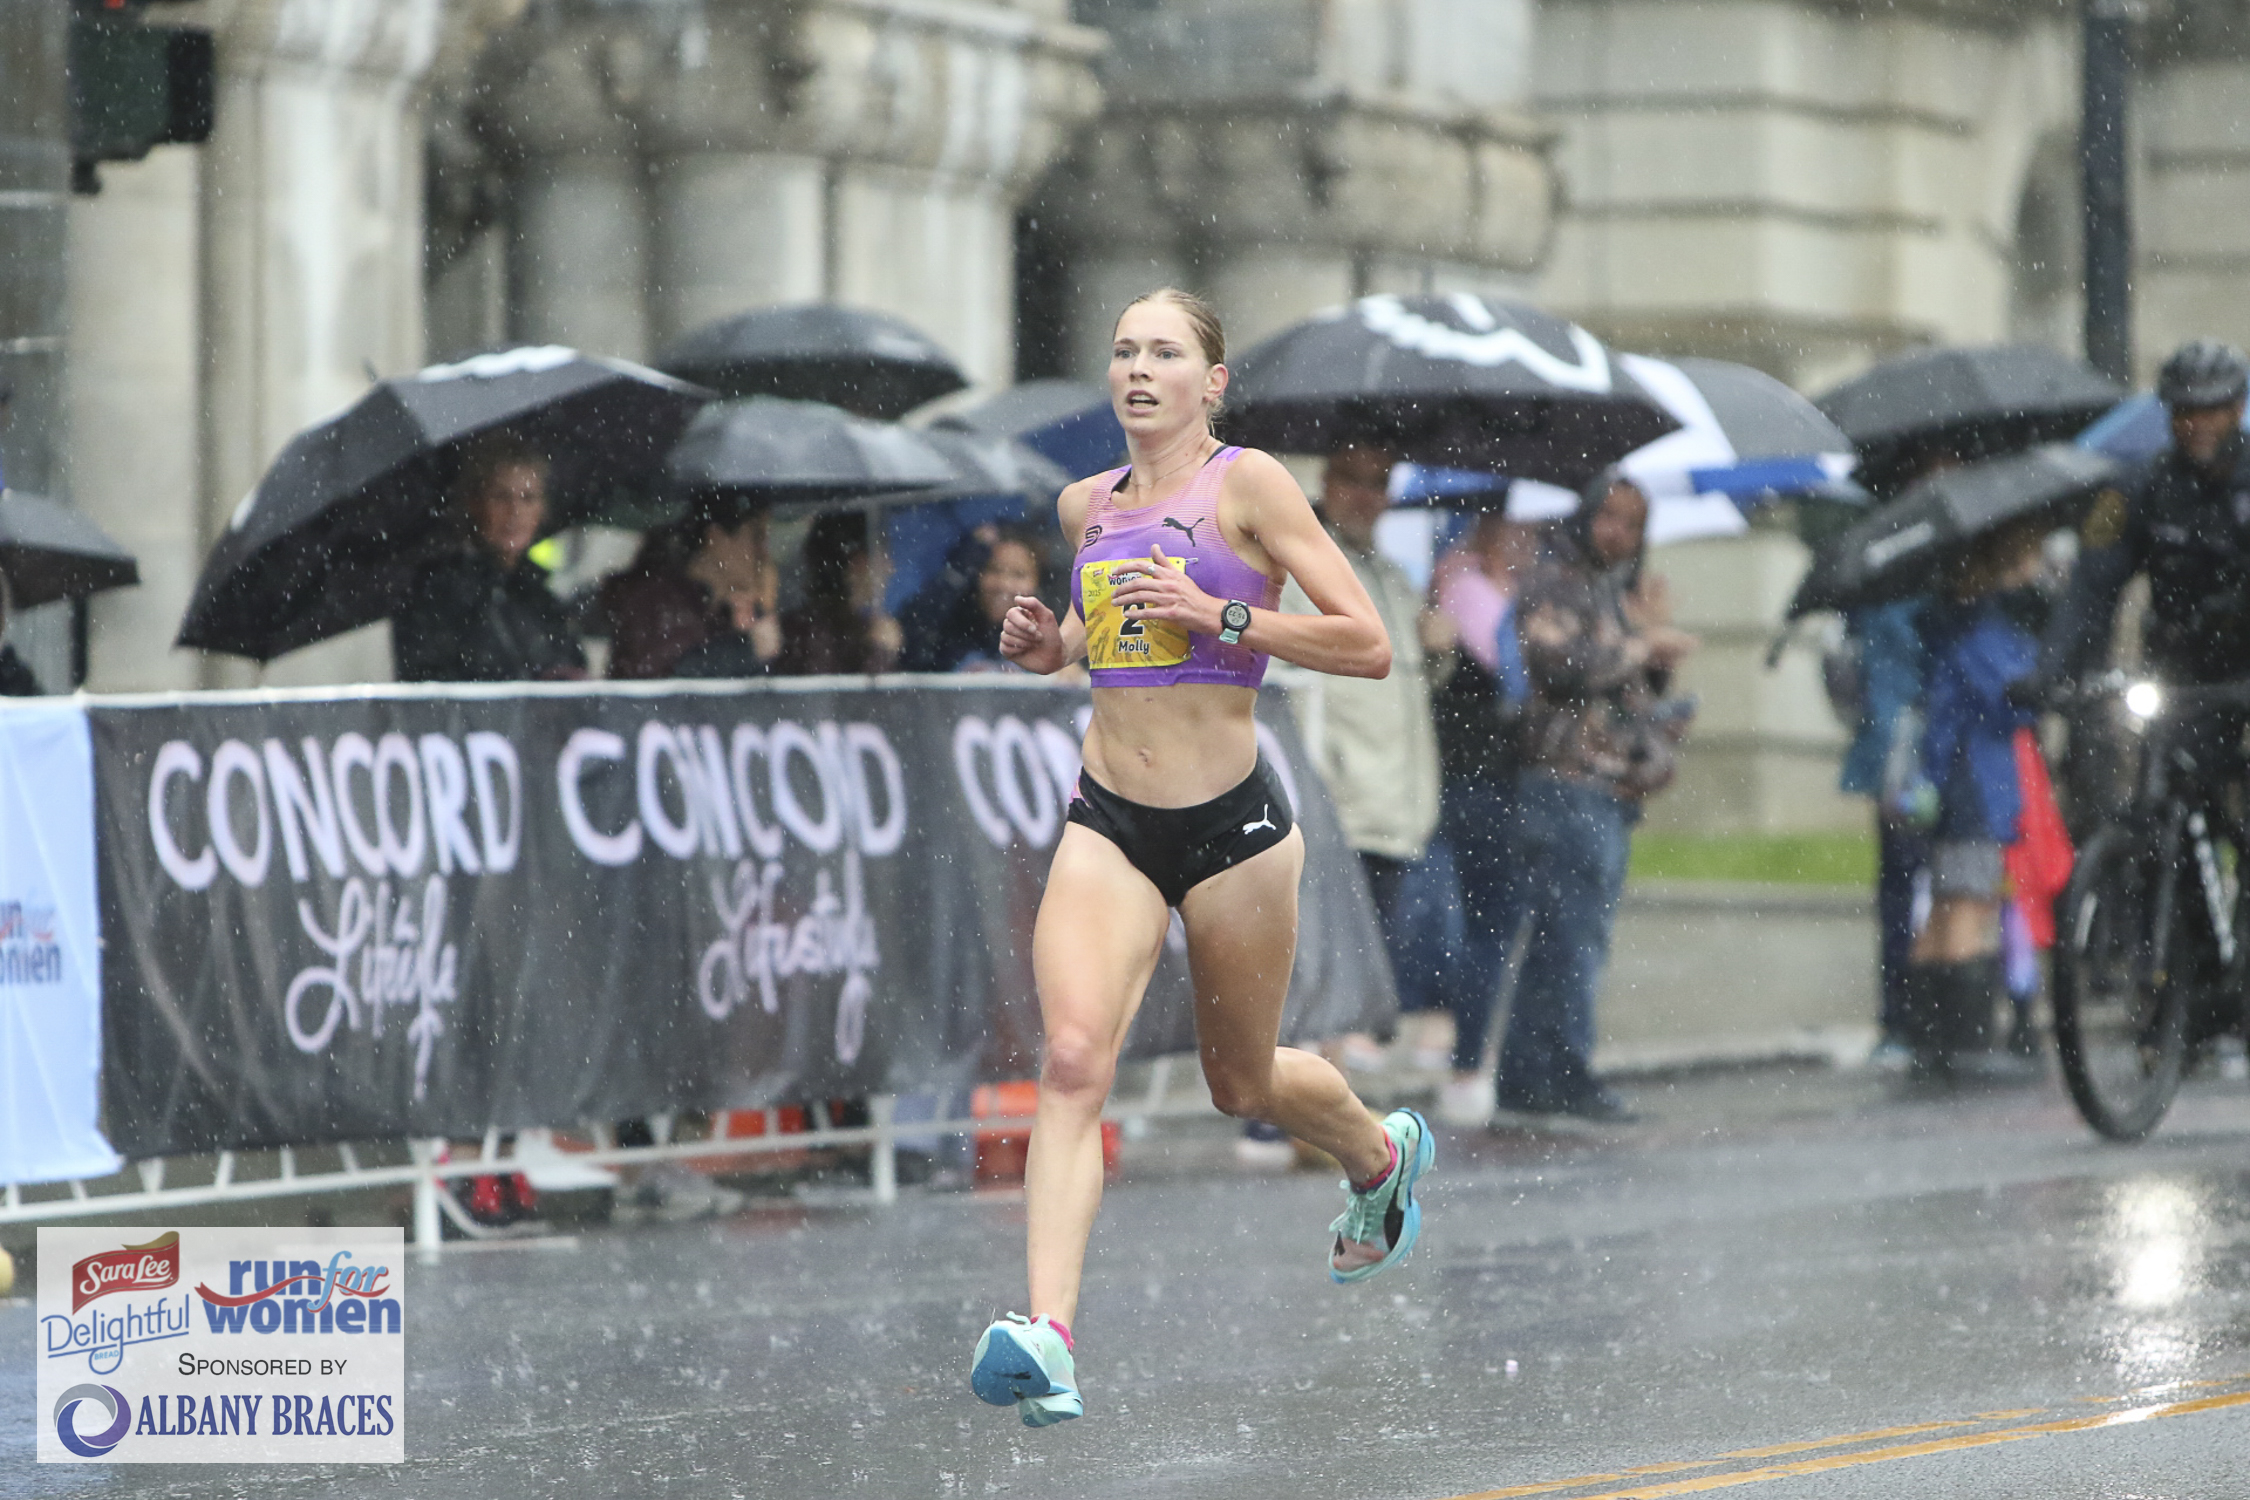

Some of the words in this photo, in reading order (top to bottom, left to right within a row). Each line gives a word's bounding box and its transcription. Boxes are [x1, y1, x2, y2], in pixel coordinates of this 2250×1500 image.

[1119, 602, 1146, 637] 2
[1118, 640, 1150, 655] Molly
[148, 730, 521, 890] CONCORD
